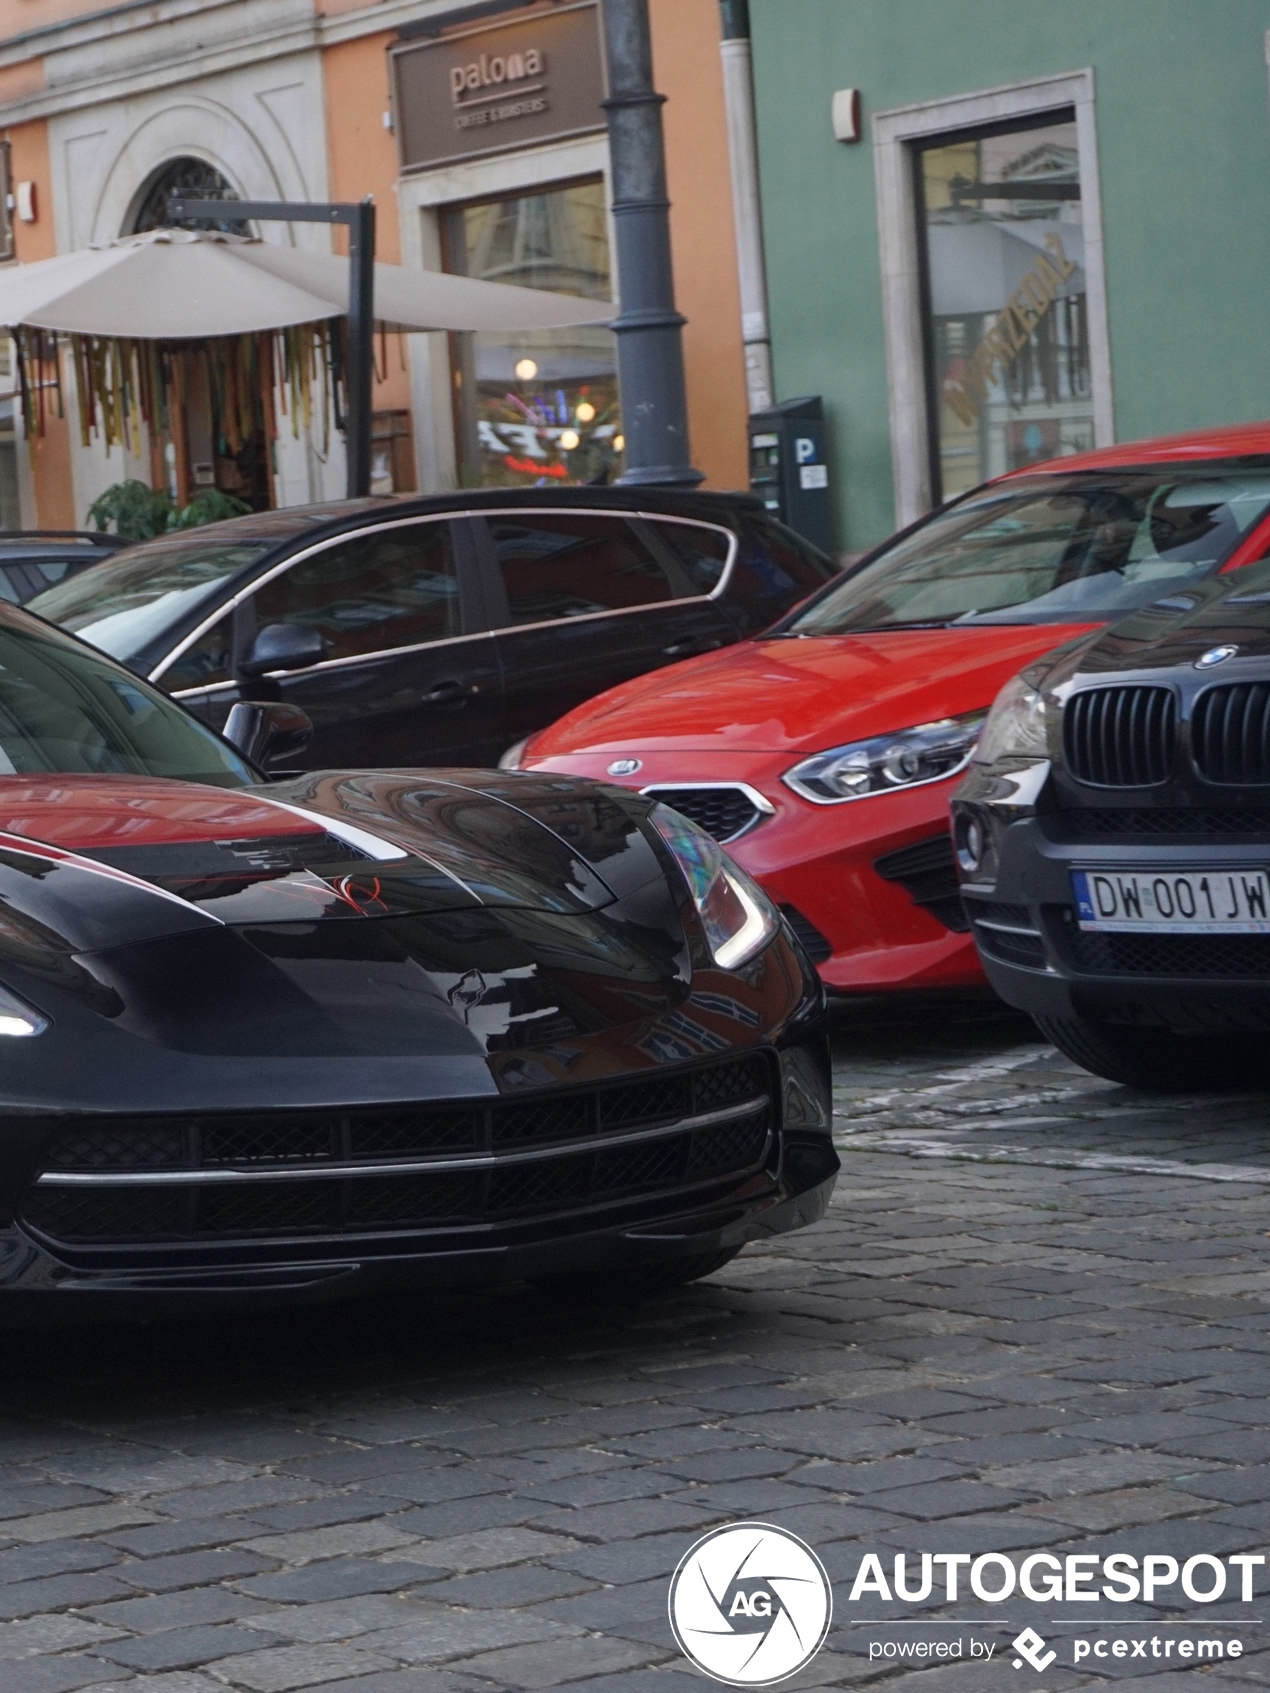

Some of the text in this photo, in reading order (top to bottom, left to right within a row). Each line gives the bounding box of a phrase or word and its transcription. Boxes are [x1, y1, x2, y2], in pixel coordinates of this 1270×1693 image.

[449, 48, 543, 102] paloma
[795, 438, 815, 464] P
[1093, 876, 1268, 919] DW 001JW
